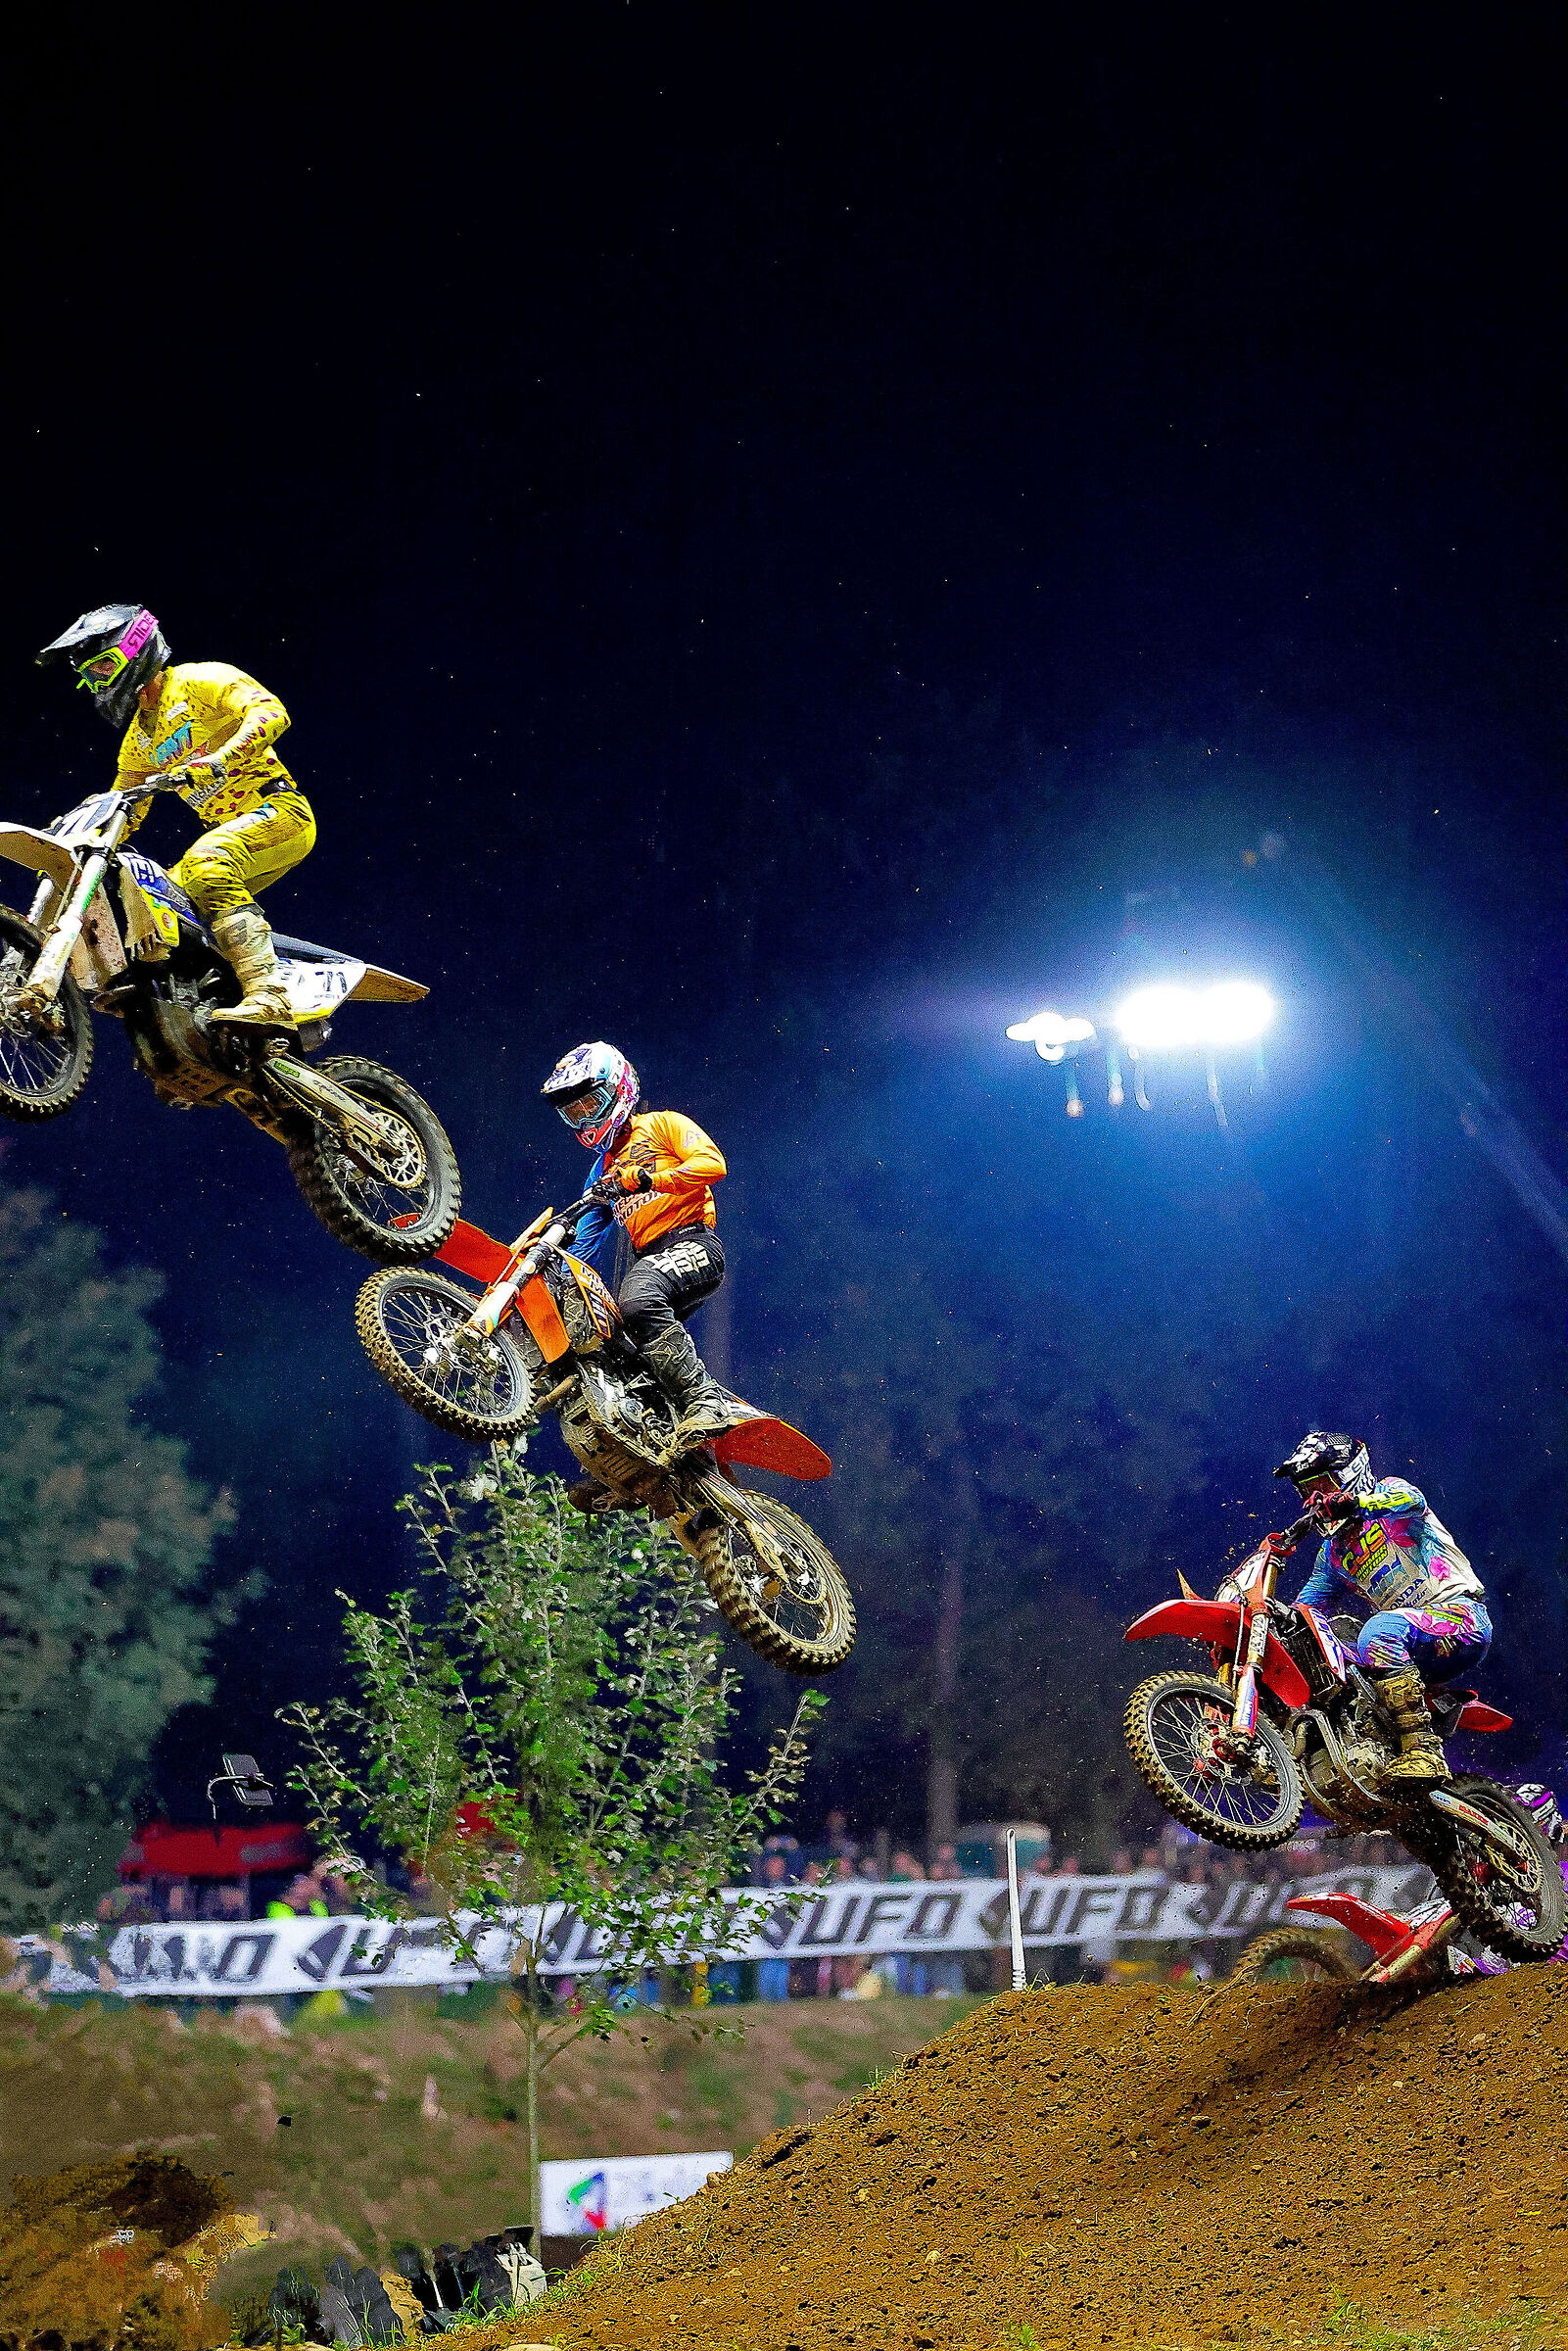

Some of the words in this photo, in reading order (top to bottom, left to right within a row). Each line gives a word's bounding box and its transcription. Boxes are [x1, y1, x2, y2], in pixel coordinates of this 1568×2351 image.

[1390, 1578, 1426, 1609] ONDA
[798, 1892, 962, 1945] UFO
[1020, 1886, 1170, 1936] UFO
